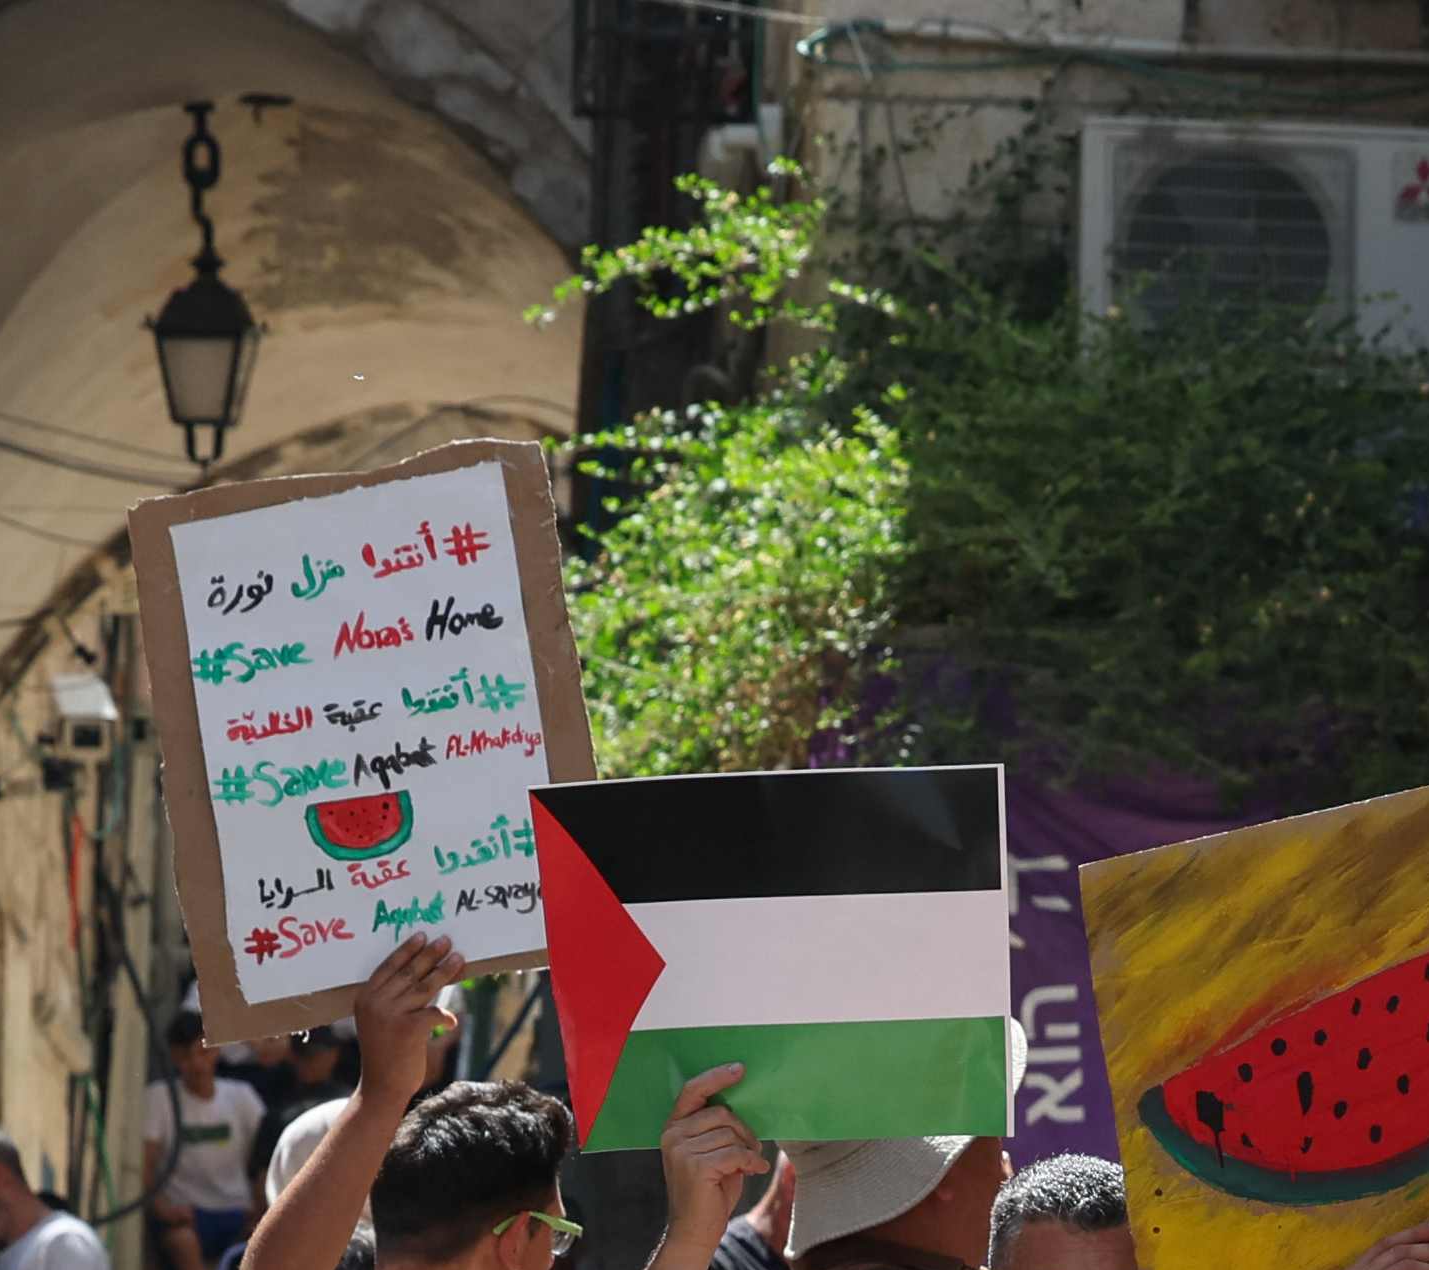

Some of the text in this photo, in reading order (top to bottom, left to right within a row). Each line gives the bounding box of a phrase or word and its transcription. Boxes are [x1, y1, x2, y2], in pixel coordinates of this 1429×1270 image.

[192, 641, 314, 686] #Save
[425, 596, 504, 642] Home
[213, 758, 349, 808] #Save
[243, 915, 355, 966] #Save
